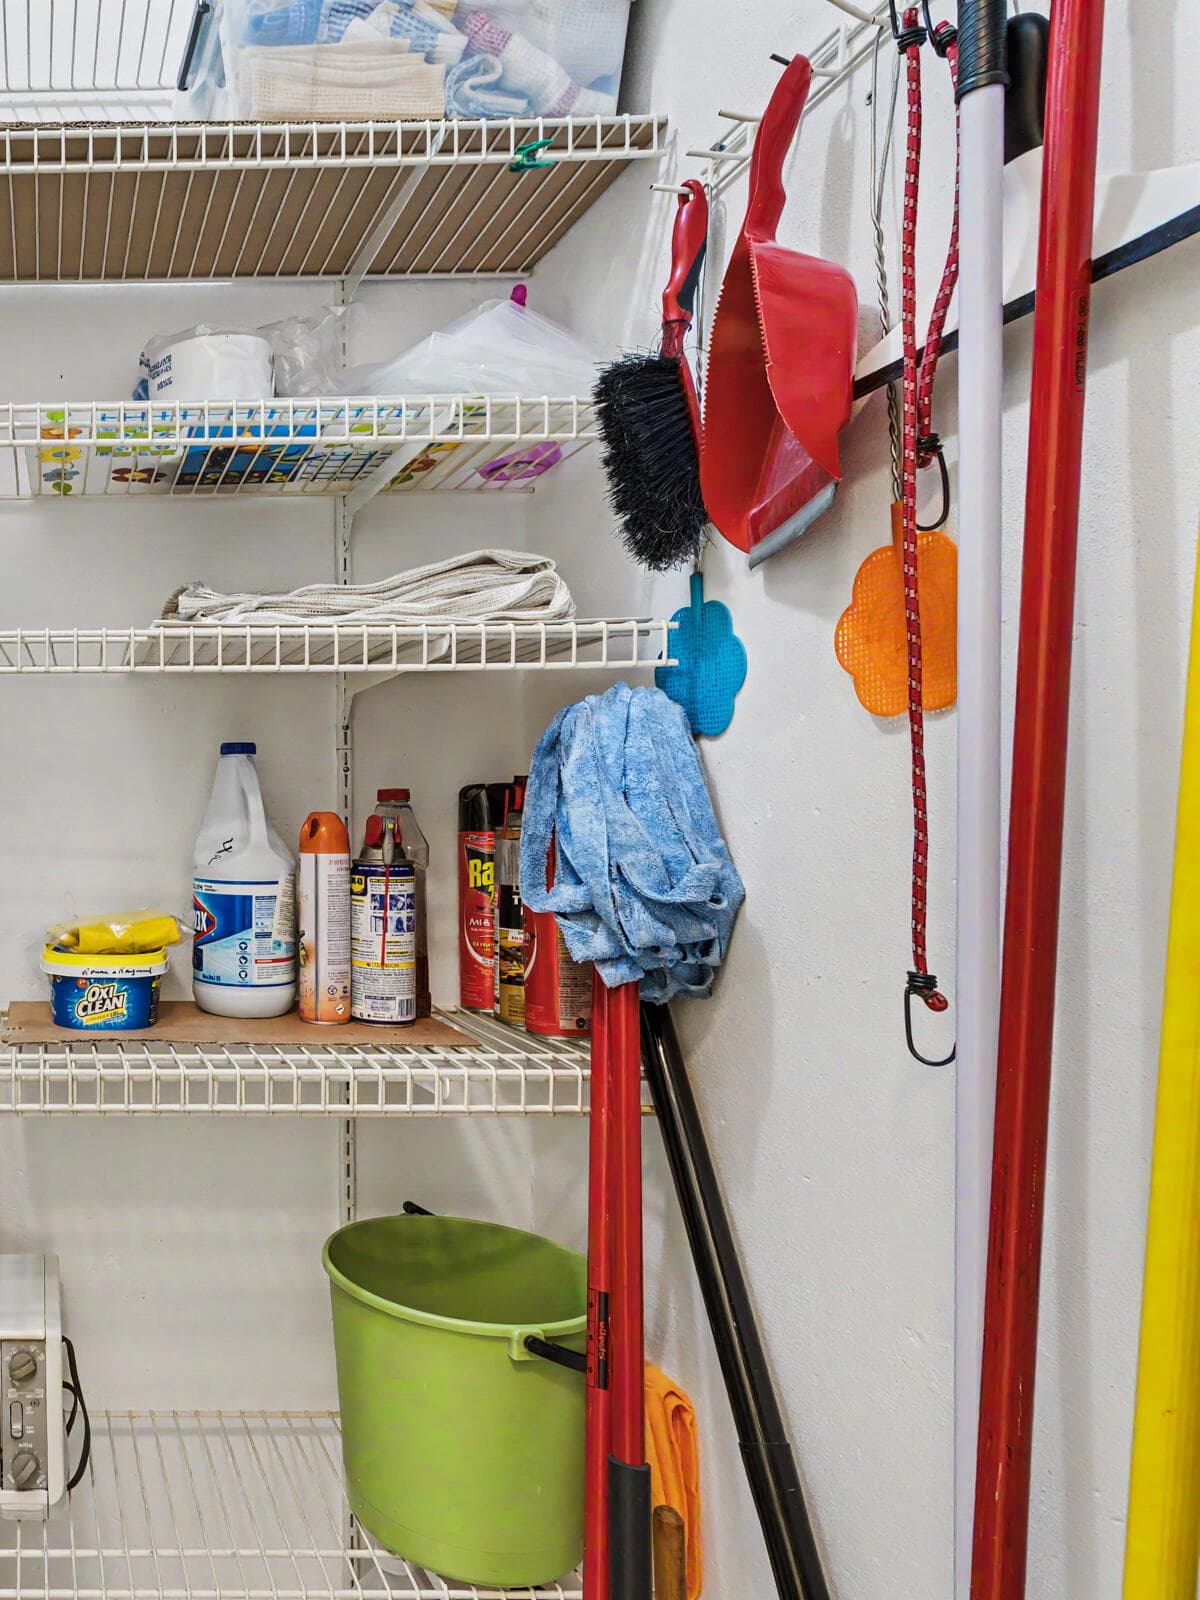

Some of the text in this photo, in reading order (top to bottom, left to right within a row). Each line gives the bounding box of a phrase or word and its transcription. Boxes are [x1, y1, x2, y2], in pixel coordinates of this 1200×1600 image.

[468, 859, 494, 888] Ra
[87, 985, 115, 1002] OXI
[77, 994, 124, 1017] CLEAN
